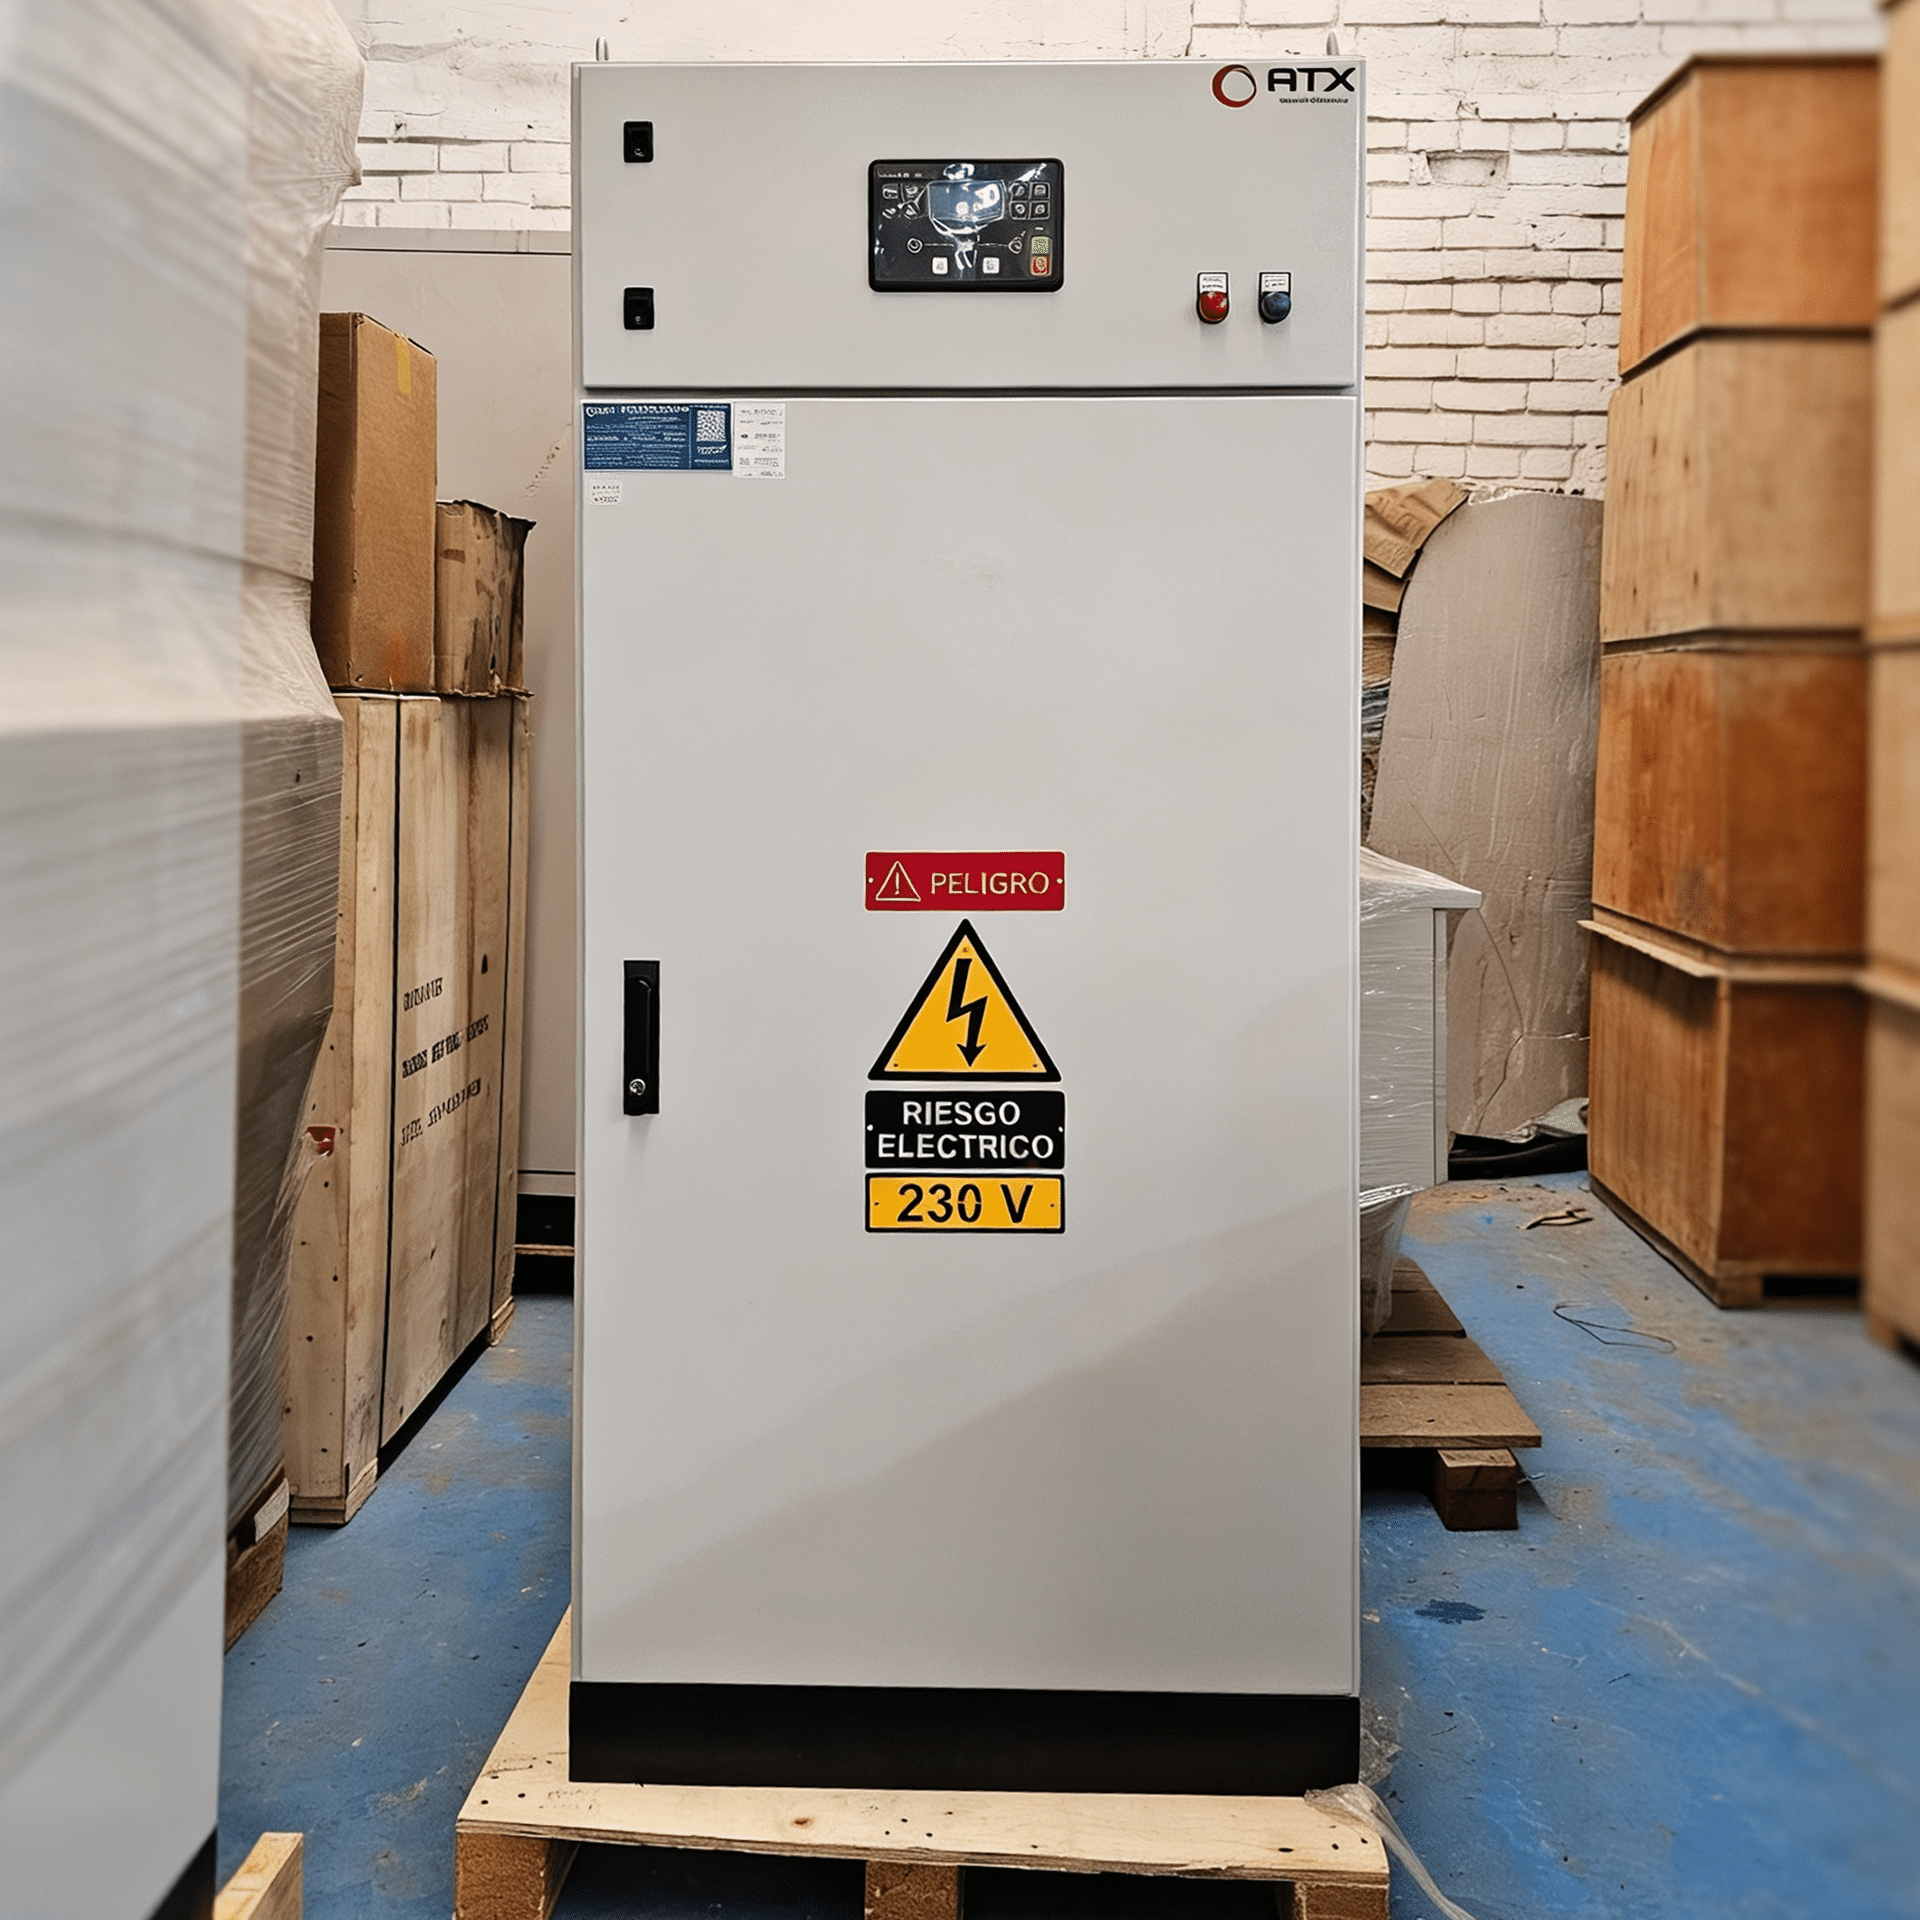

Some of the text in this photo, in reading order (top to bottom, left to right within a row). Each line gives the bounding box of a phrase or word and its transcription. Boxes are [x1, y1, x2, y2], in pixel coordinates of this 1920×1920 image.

[1267, 67, 1356, 92] ATX
[930, 871, 1050, 896] PELIGRO
[902, 1100, 1021, 1126] RIESGO
[877, 1133, 1054, 1159] ELECTRICO
[897, 1183, 1034, 1224] 230 V
